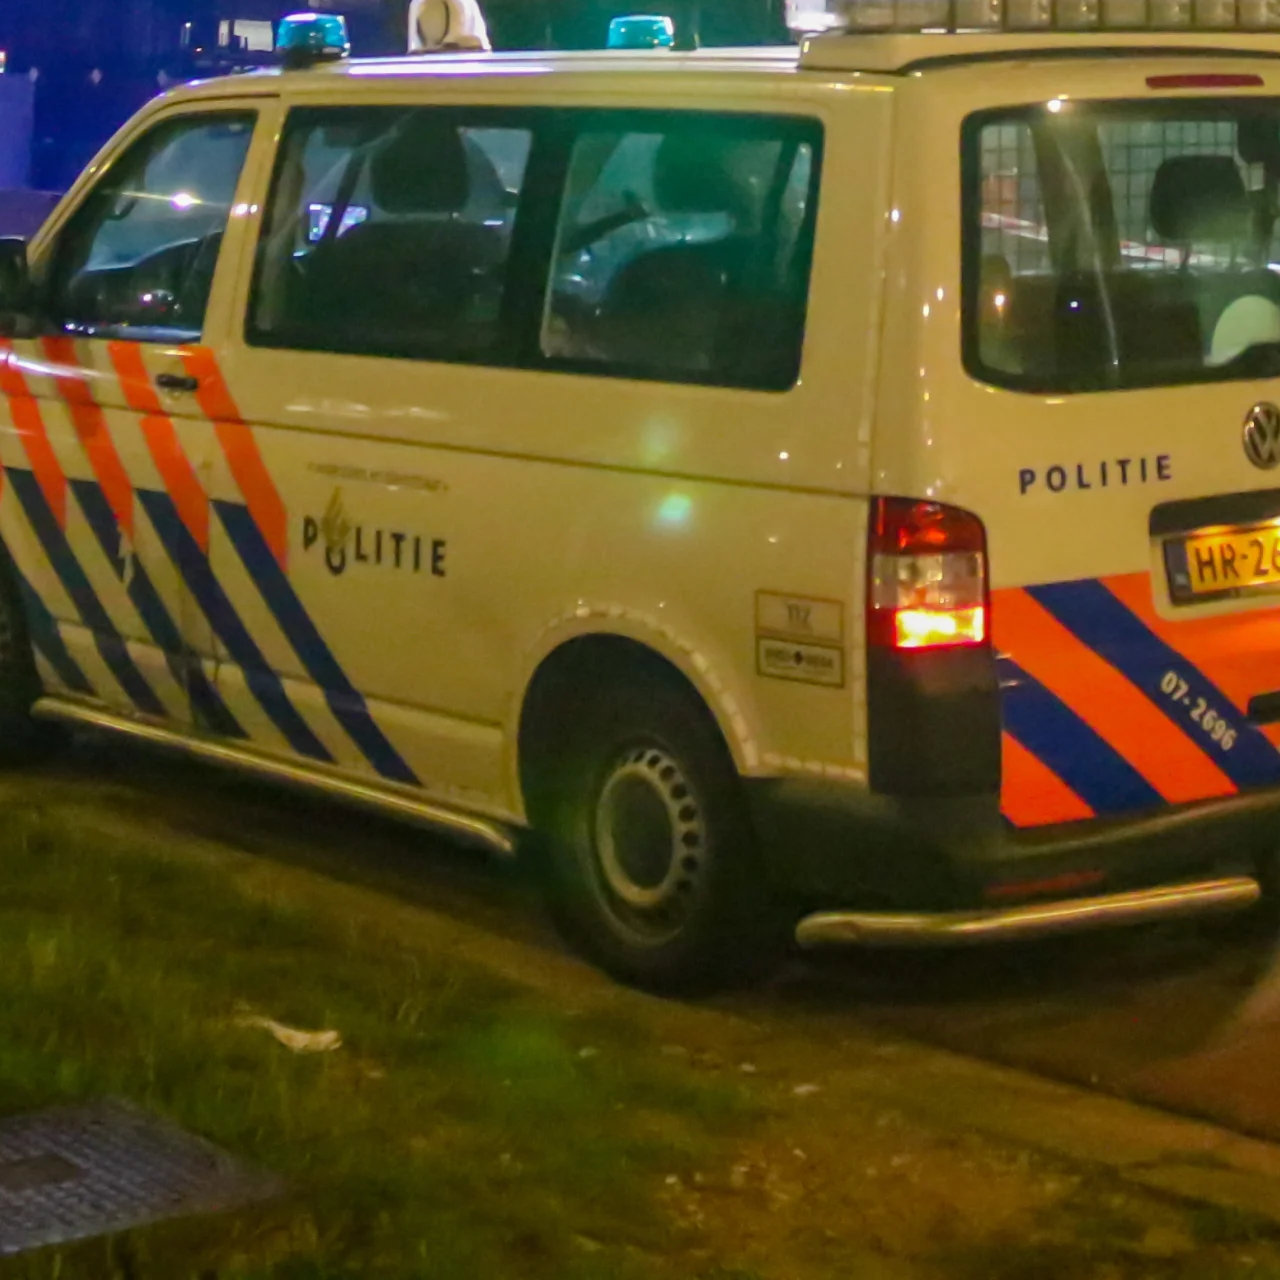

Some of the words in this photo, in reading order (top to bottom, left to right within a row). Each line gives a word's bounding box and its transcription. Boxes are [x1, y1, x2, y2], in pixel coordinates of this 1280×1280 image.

[1018, 453, 1174, 495] POLITIE
[302, 514, 447, 578] POLITIE
[1159, 669, 1239, 752] 07-2696
